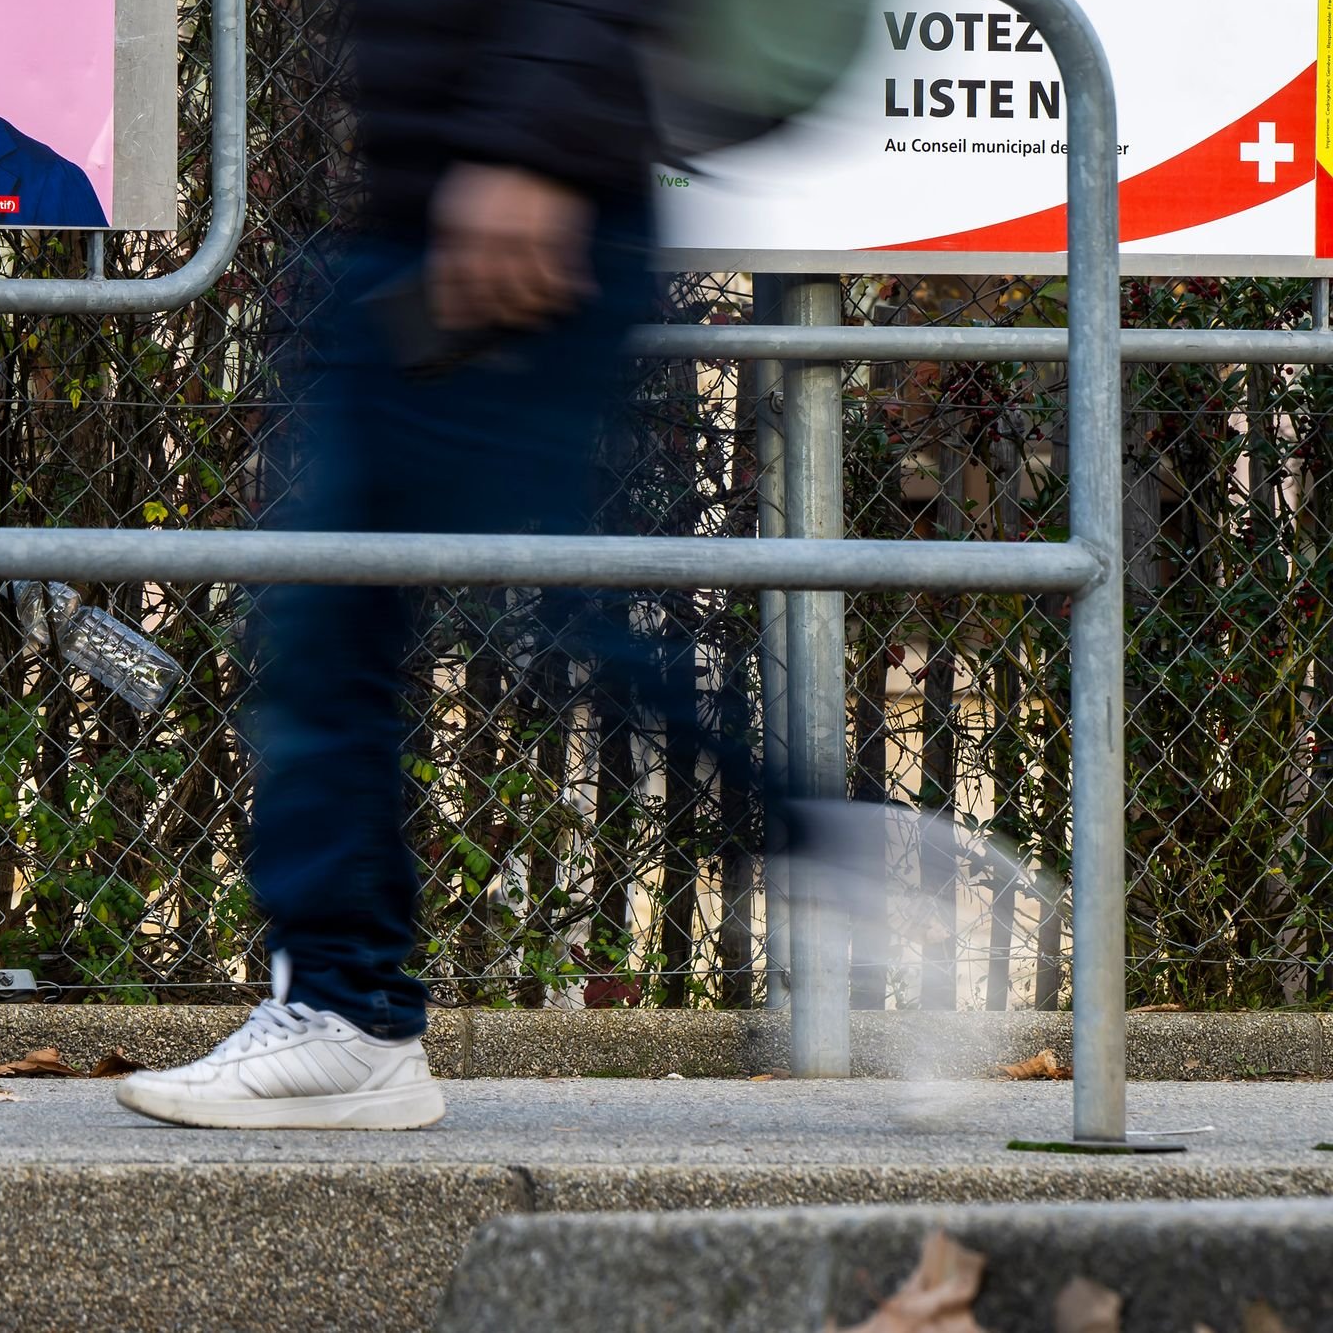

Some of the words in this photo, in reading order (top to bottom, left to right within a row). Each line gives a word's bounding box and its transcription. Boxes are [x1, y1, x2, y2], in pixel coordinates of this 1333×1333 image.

[884, 11, 1044, 52] VOTEZ
[885, 78, 1013, 118] LISTE
[885, 139, 906, 153] Au
[912, 139, 966, 154] Conseil
[972, 139, 1045, 156] municipal
[657, 174, 690, 188] Yves
